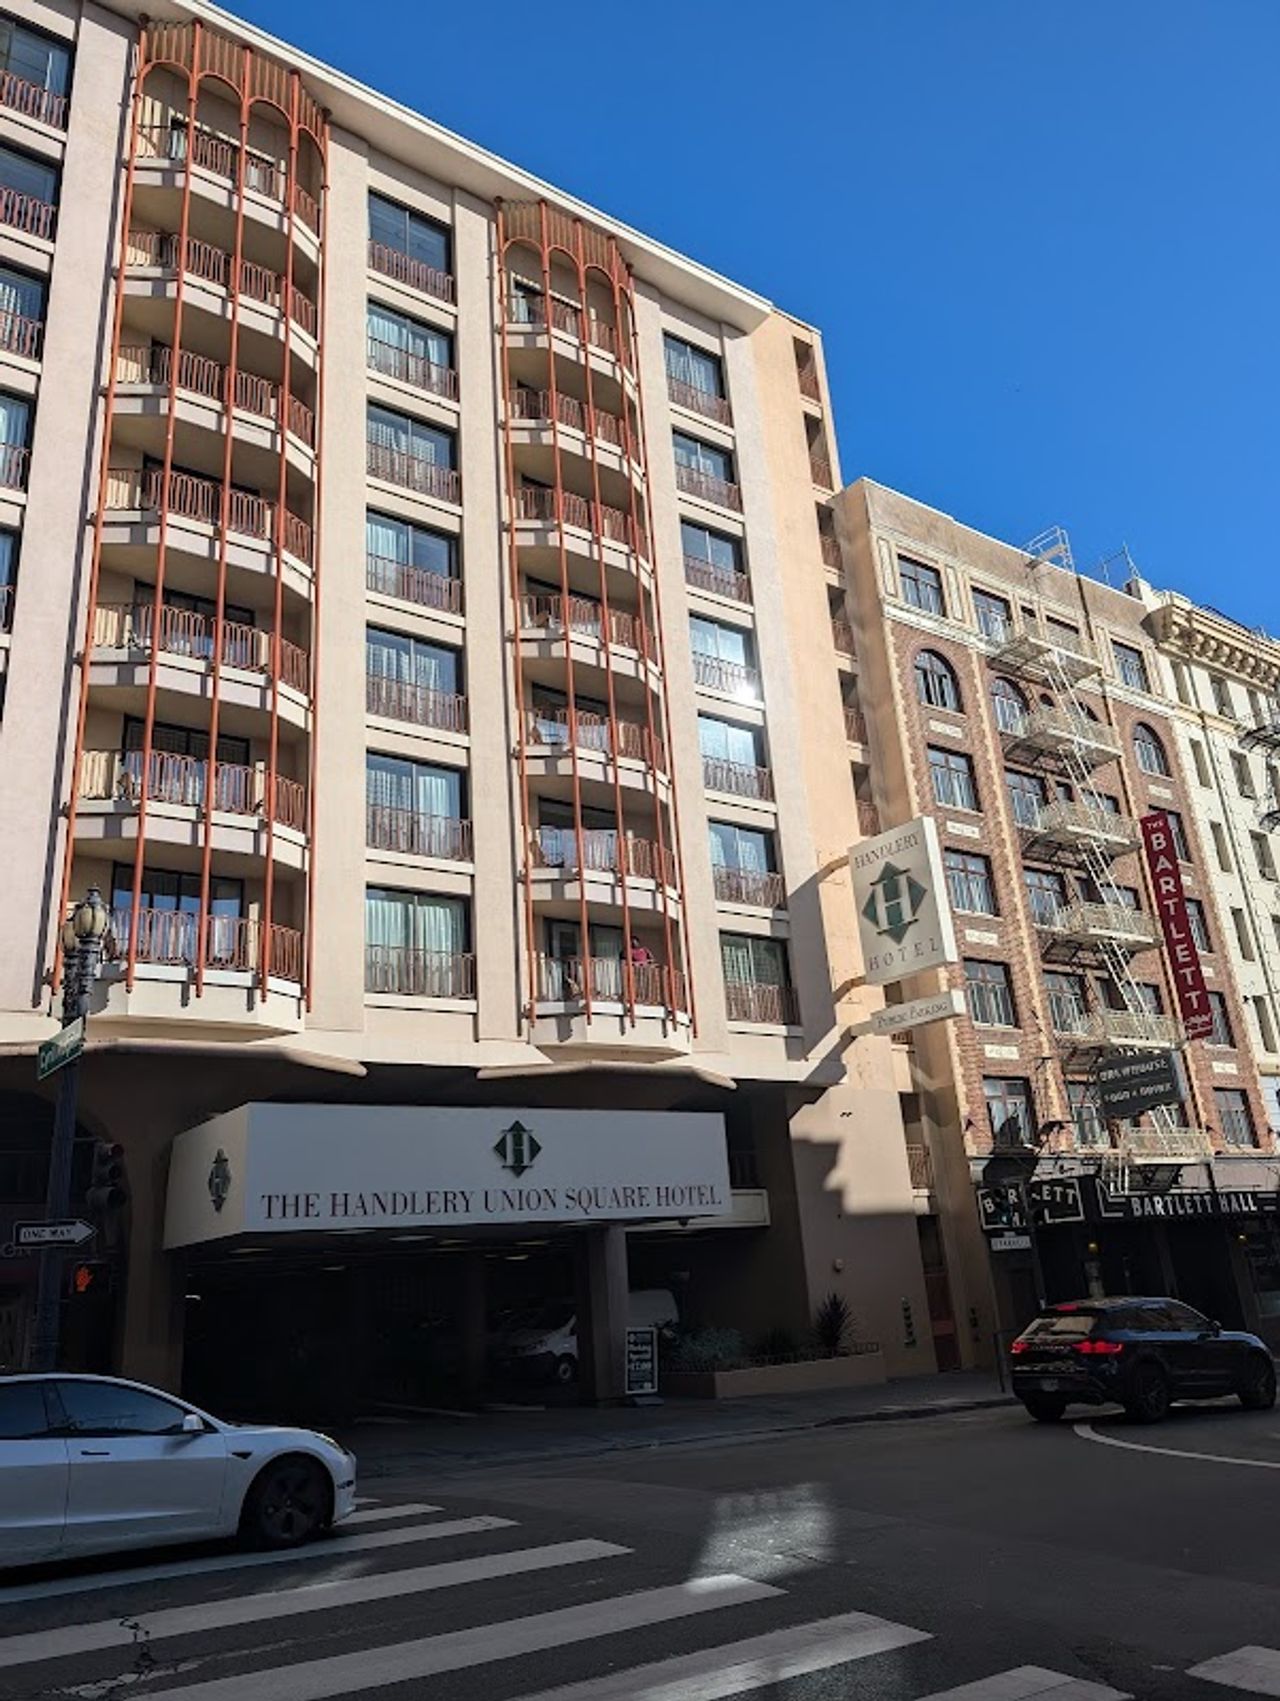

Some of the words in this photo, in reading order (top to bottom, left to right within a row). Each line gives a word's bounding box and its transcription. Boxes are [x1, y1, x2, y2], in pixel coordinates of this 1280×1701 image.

[1146, 821, 1165, 830] THE
[854, 831, 921, 869] HANDLERY
[1150, 832, 1203, 1010] BARTLETT
[868, 937, 939, 972] HOTEL
[261, 1192, 321, 1220] THE
[329, 1190, 475, 1218] HANDLERY
[483, 1187, 558, 1213] UNION
[565, 1186, 651, 1215] SQUARE
[656, 1184, 723, 1207] HOTEL
[983, 1184, 1076, 1214] BRETT
[1131, 1195, 1213, 1217] BARTLETT
[1218, 1193, 1258, 1214] HALL
[23, 1228, 46, 1239] ONE
[49, 1228, 72, 1238] WAY
